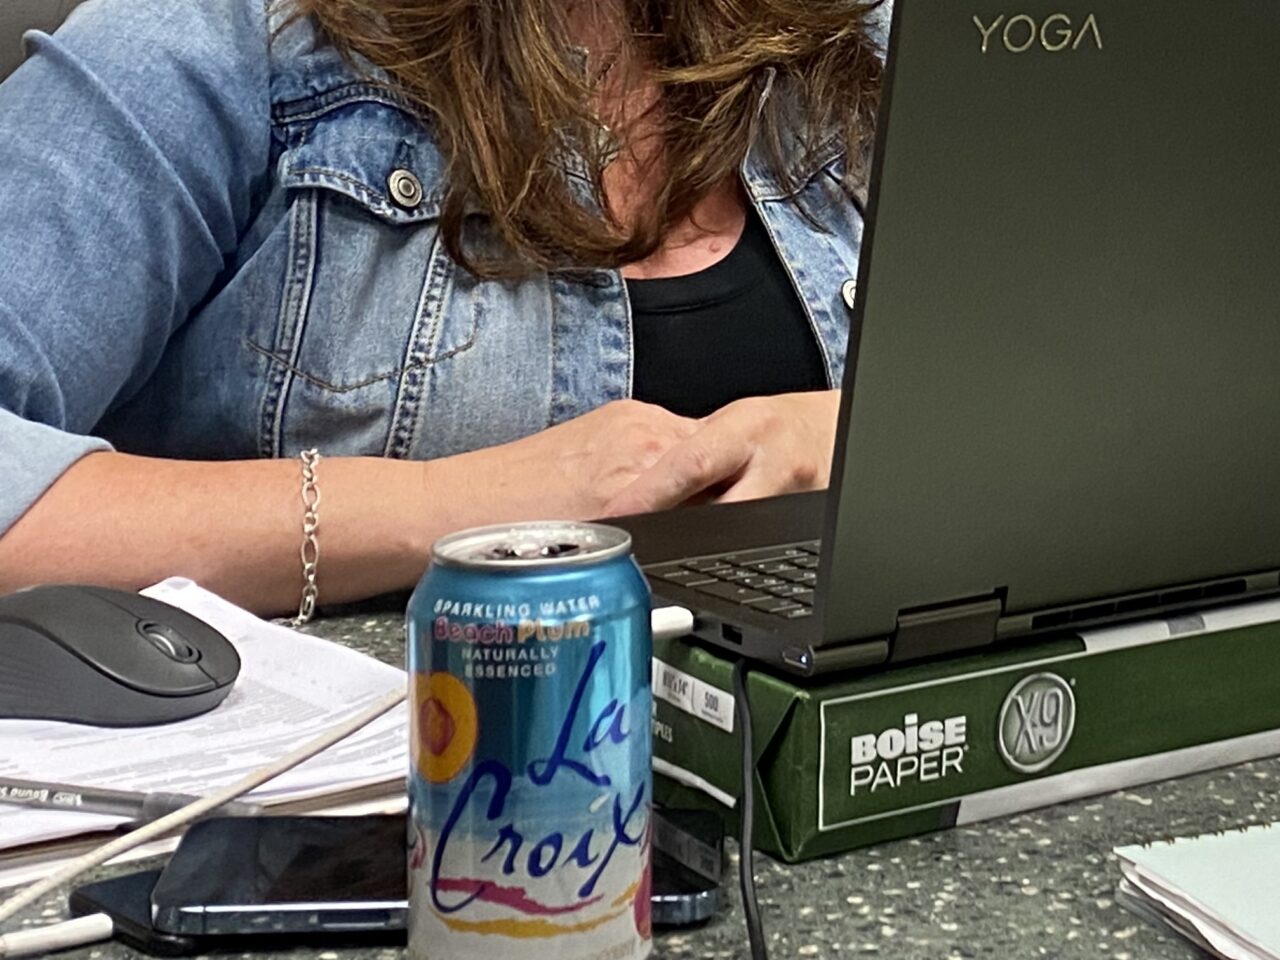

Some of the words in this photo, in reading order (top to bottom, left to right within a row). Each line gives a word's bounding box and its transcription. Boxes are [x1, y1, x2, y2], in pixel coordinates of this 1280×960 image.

[973, 13, 1102, 53] YOGA
[433, 598, 531, 618] SPARKLING
[540, 594, 601, 616] WATER
[433, 614, 514, 645] Beach
[516, 617, 591, 643] Plum
[461, 645, 560, 662] NATURALLY
[464, 662, 557, 678] ESSENCED
[527, 639, 633, 787] La
[850, 745, 965, 796] PAPER
[430, 760, 645, 913] Croix
